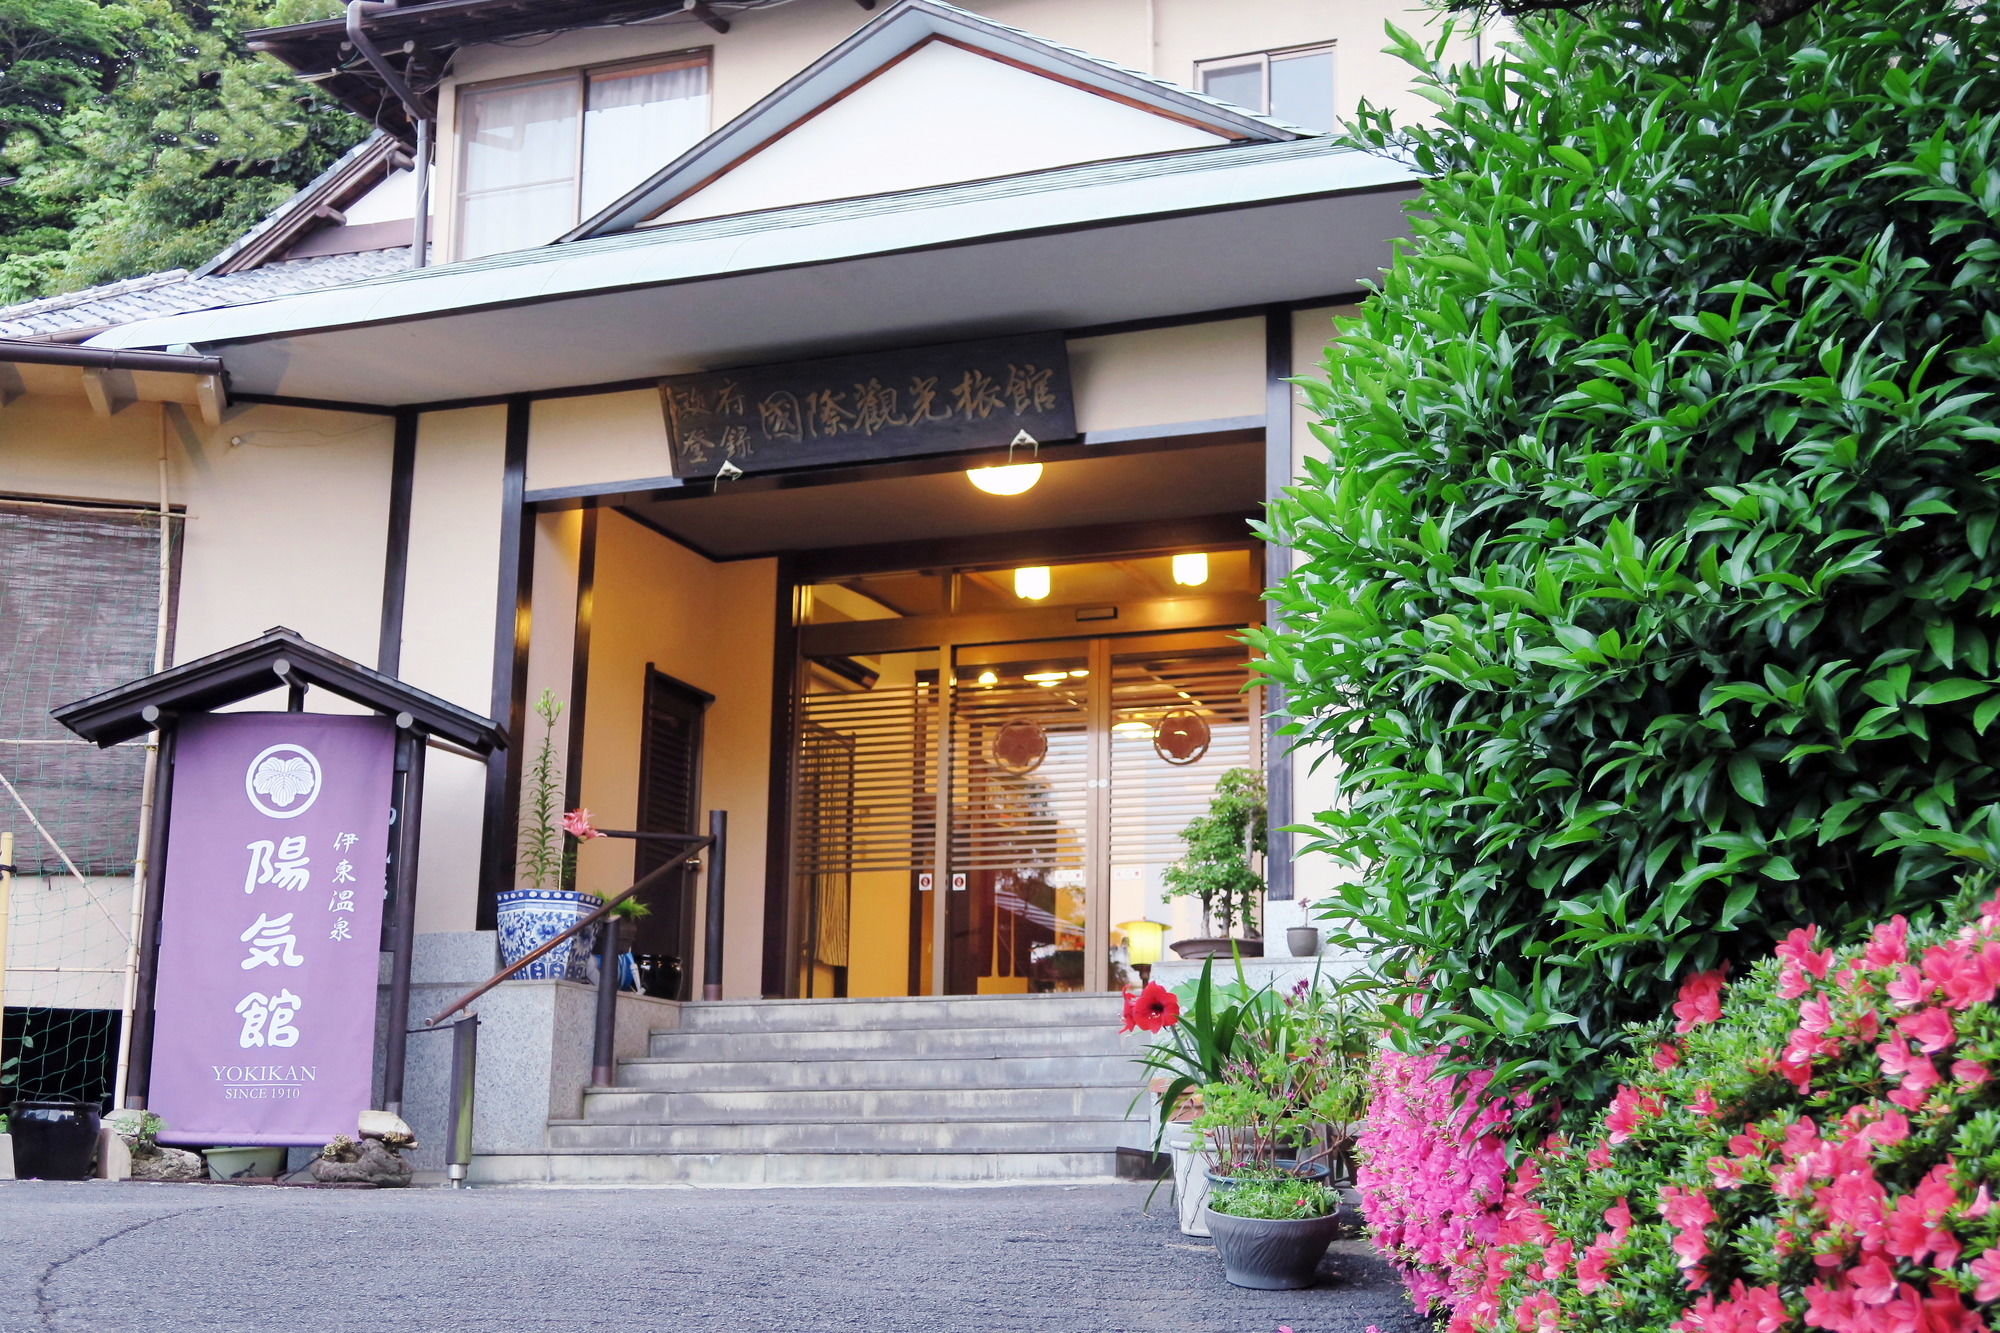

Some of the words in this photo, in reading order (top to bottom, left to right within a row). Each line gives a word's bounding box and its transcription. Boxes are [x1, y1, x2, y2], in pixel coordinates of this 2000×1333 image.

[328, 831, 359, 942] 伊東温泉
[234, 835, 311, 1049] 陽気館
[212, 1065, 318, 1082] YOKIKAN
[225, 1087, 268, 1100] SINCE
[271, 1087, 301, 1100] 1910
